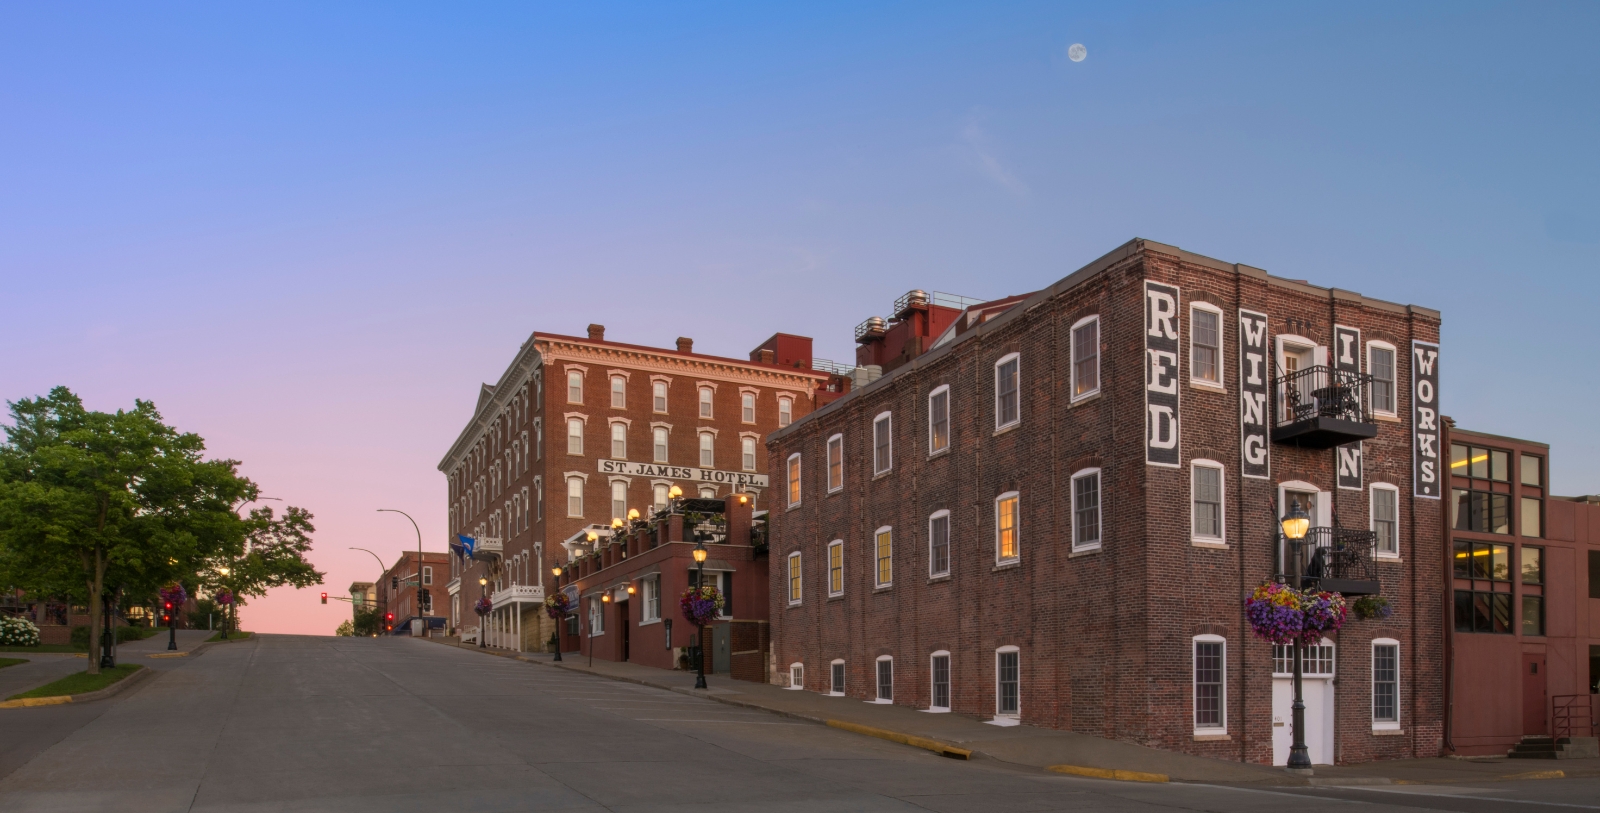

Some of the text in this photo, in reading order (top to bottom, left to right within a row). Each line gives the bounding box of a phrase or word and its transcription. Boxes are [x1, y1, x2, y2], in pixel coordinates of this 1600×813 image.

[1147, 289, 1178, 449] RED
[1241, 316, 1267, 466] WING
[1339, 333, 1360, 478] IN
[1414, 347, 1438, 494] WORKS.
[603, 460, 764, 486] ST. JAMES HOTEL.
